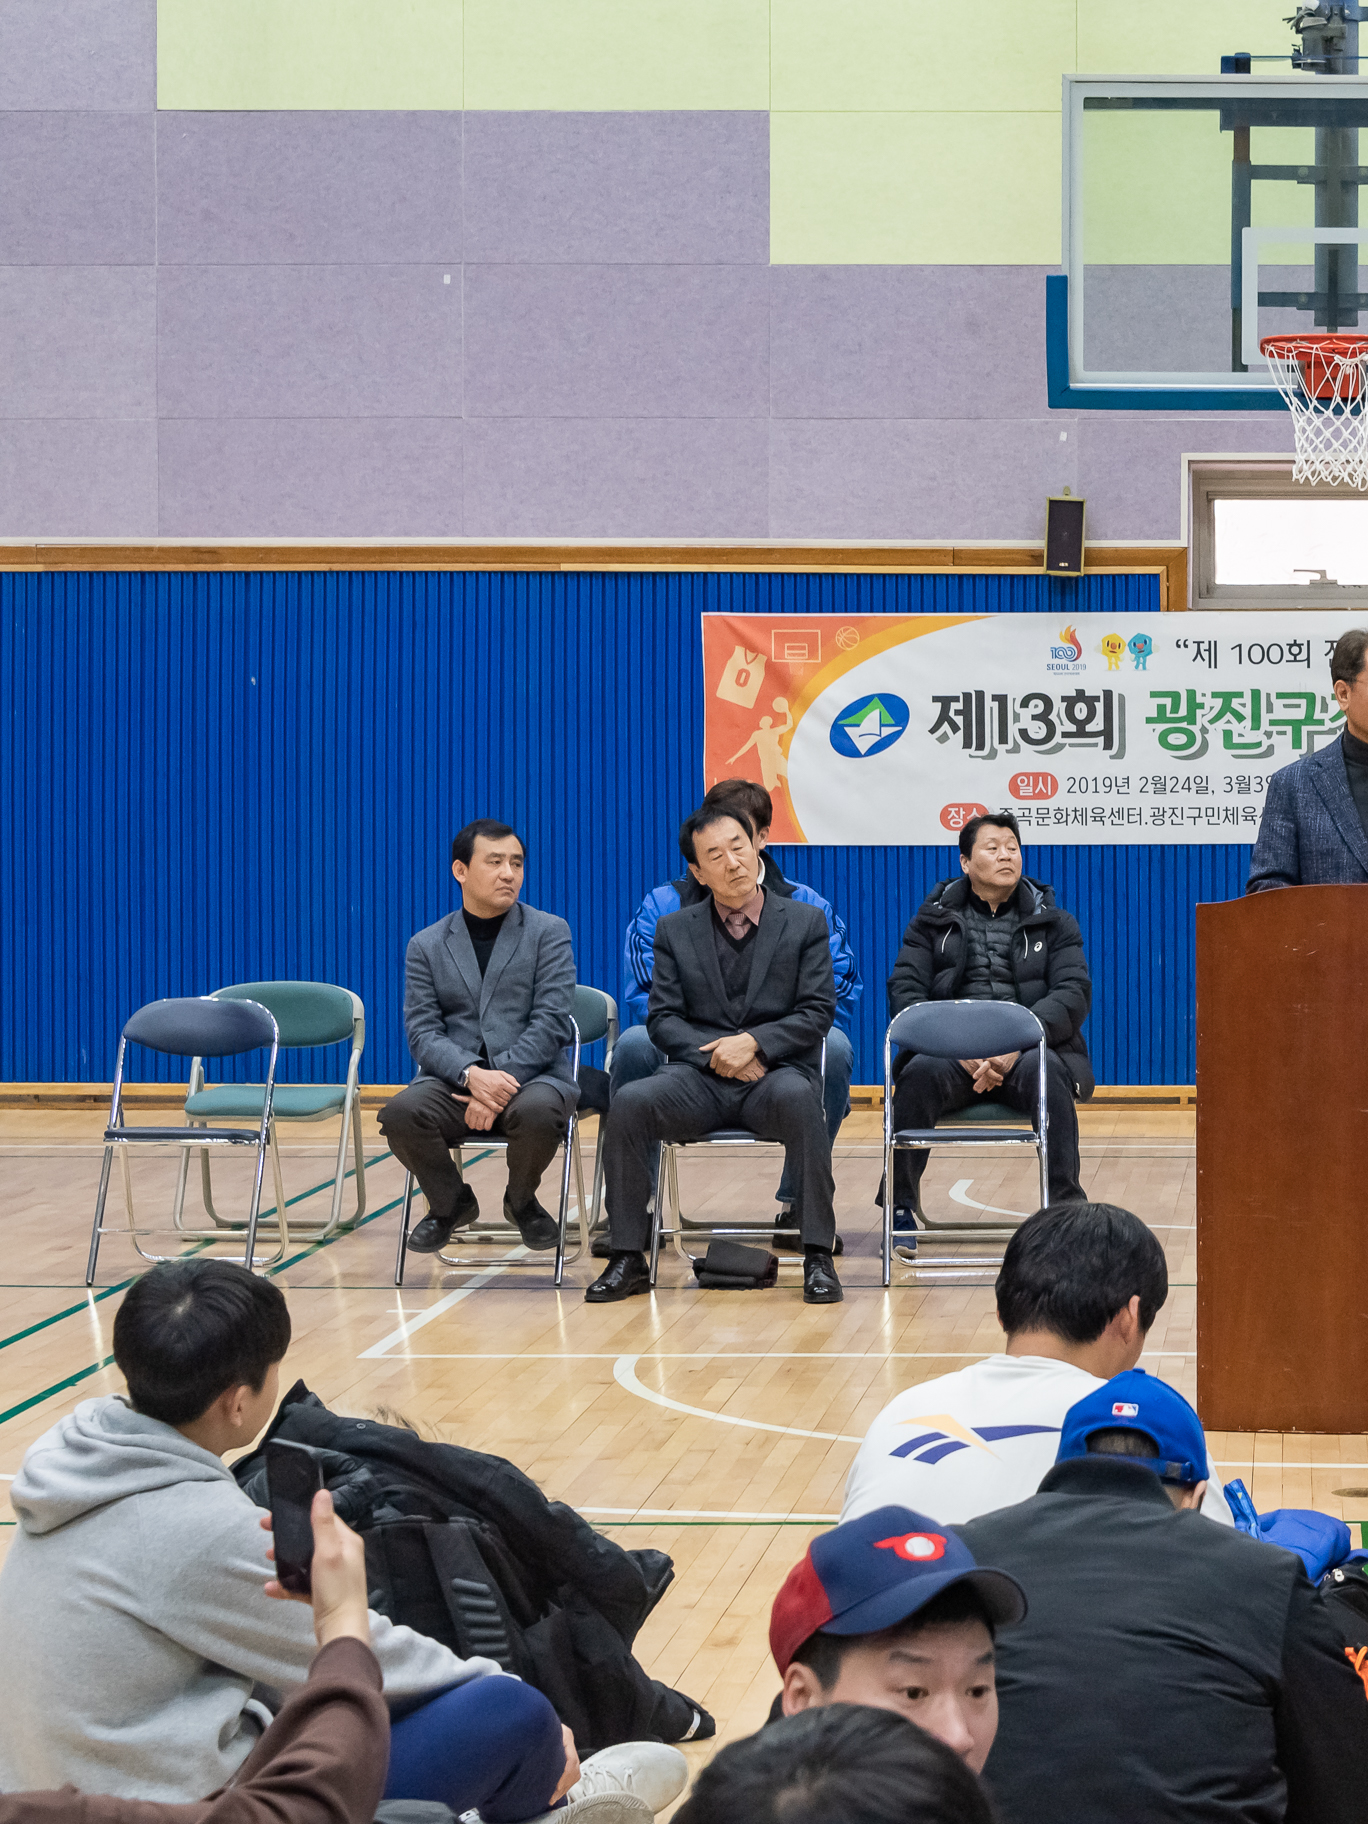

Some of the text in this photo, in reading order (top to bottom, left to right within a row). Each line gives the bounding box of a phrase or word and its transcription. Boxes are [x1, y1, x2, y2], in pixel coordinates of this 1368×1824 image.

[1175, 639, 1217, 669] “제
[1230, 639, 1311, 669] 100회
[1046, 663, 1087, 671] SEOUL 2019
[928, 688, 1114, 751] 제13회
[1017, 776, 1051, 796] 일시
[1066, 775, 1131, 795] 2019년
[1138, 775, 1215, 796] 2월24일,
